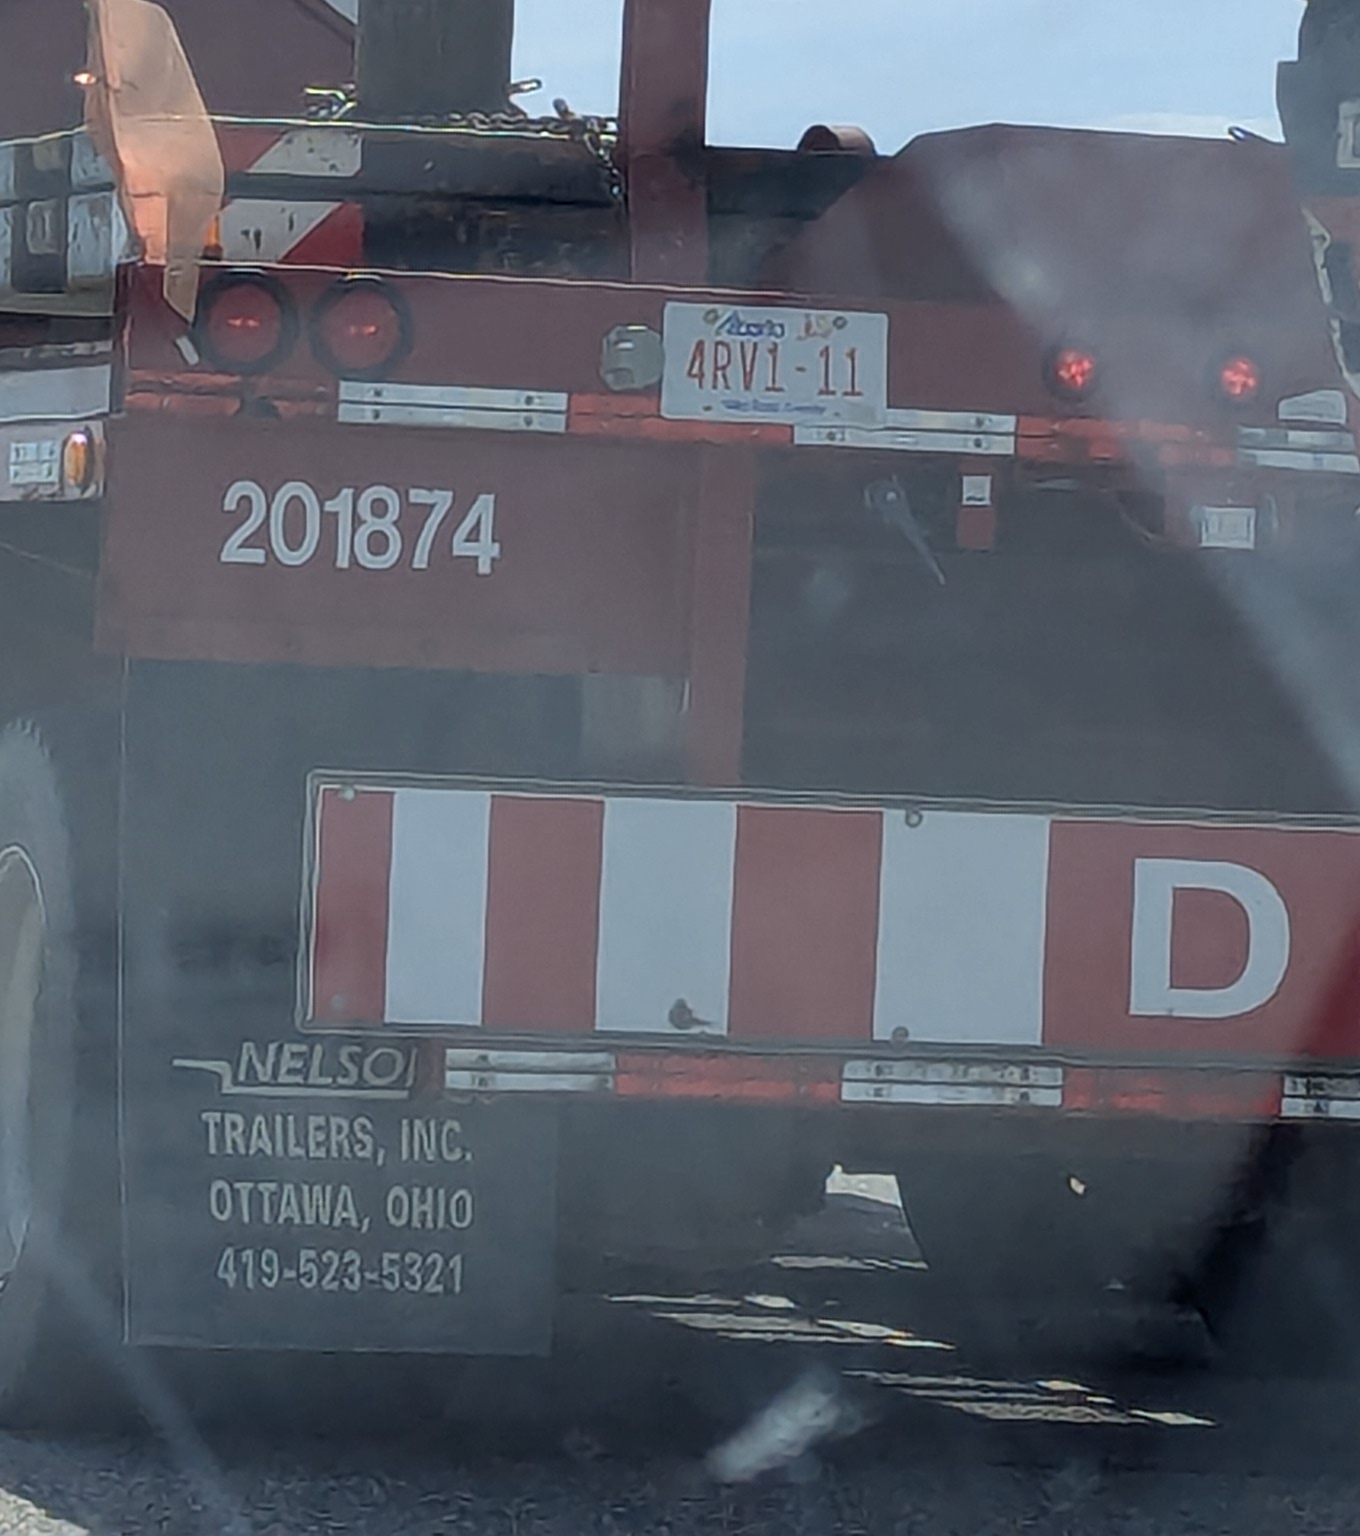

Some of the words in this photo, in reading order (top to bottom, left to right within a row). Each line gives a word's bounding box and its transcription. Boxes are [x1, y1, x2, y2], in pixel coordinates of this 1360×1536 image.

[686, 339, 864, 397] 4RV1-11
[220, 480, 501, 575] 201874
[1129, 857, 1291, 1019] D
[200, 1111, 385, 1166] TRAILERS,
[401, 1118, 474, 1163] INC.
[208, 1179, 372, 1233] OTTAWA,
[386, 1185, 474, 1230] OHIO
[216, 1245, 465, 1295] 419-523-5321
